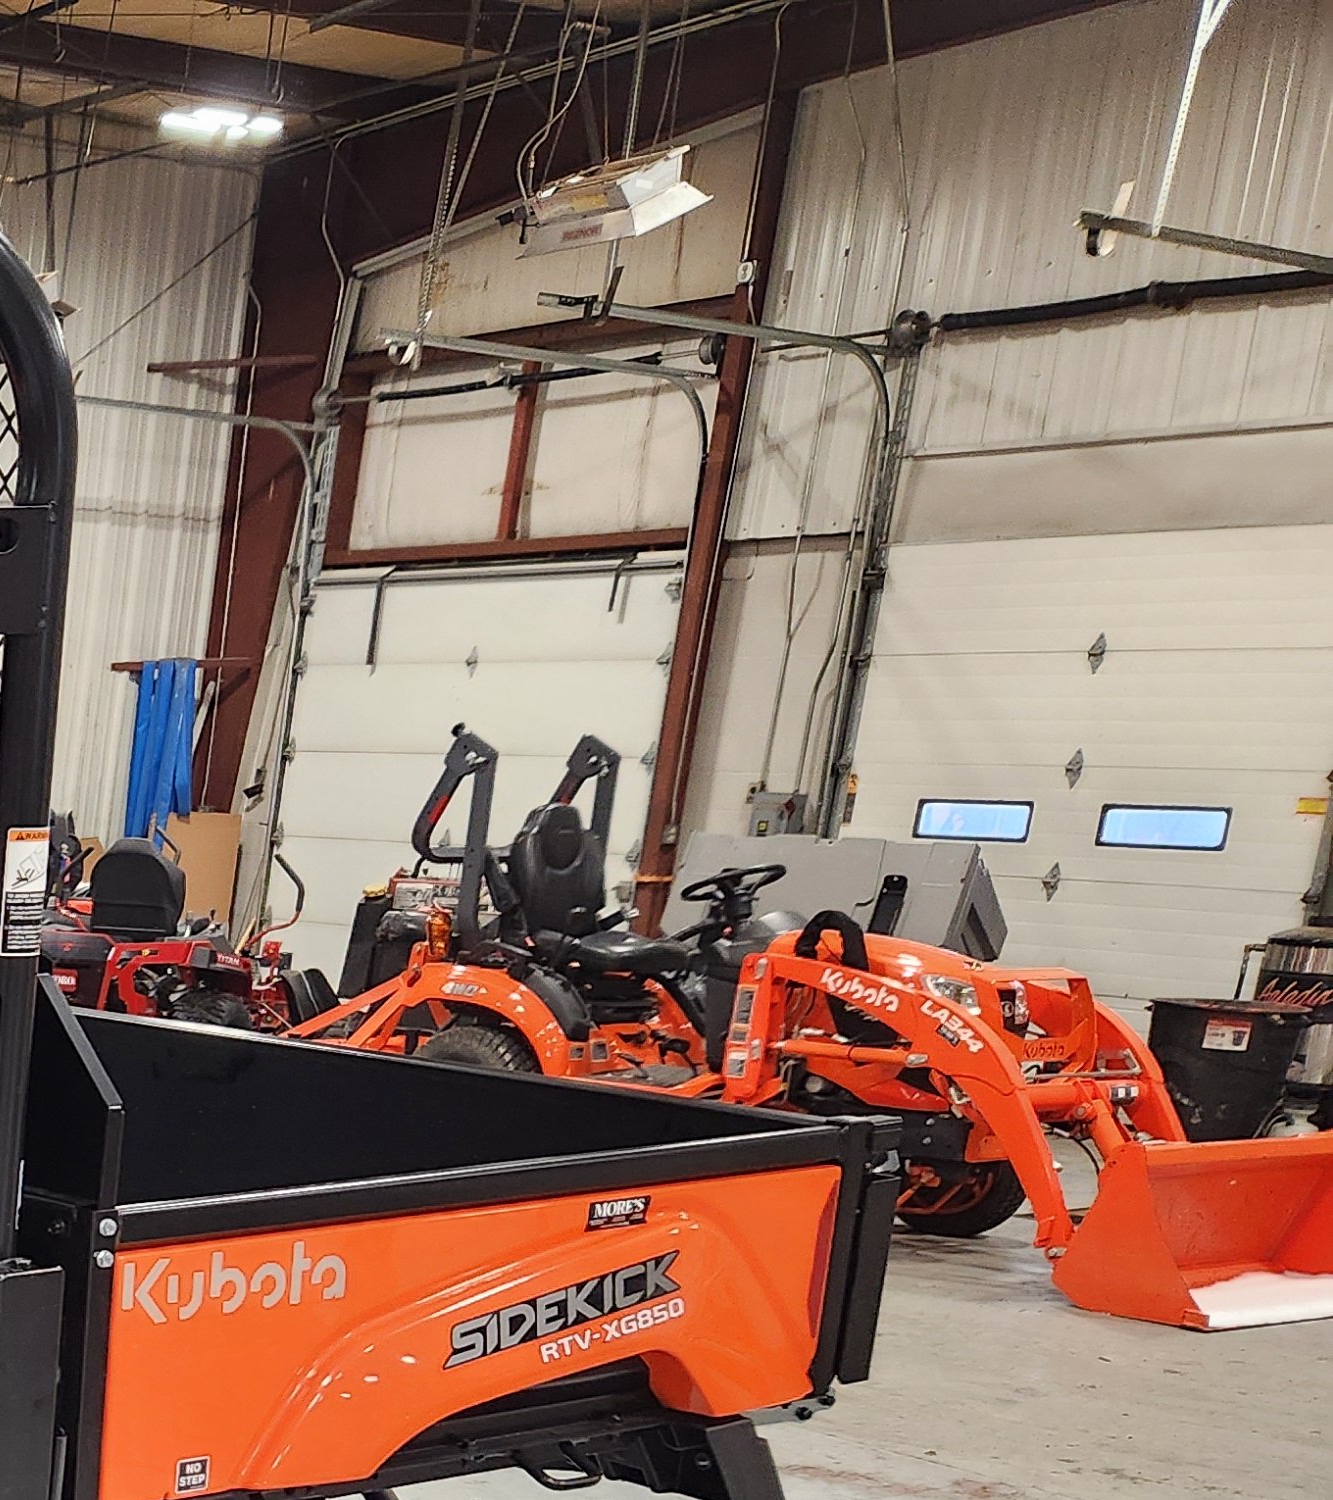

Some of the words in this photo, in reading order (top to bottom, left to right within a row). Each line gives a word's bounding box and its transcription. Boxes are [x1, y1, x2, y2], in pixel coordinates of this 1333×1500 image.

[52, 975, 76, 986] ORO
[440, 981, 481, 998] 4WD
[820, 968, 900, 1012] Kubota
[920, 999, 985, 1053] LA344
[1023, 1041, 1065, 1059] Kubota
[593, 1198, 646, 1219] MORE'S
[121, 1240, 347, 1325] Kubota
[444, 1251, 681, 1369] SIDEKICK
[539, 1298, 686, 1364] RTV-XG850
[185, 1462, 202, 1475] NO
[179, 1473, 205, 1487] STEP
